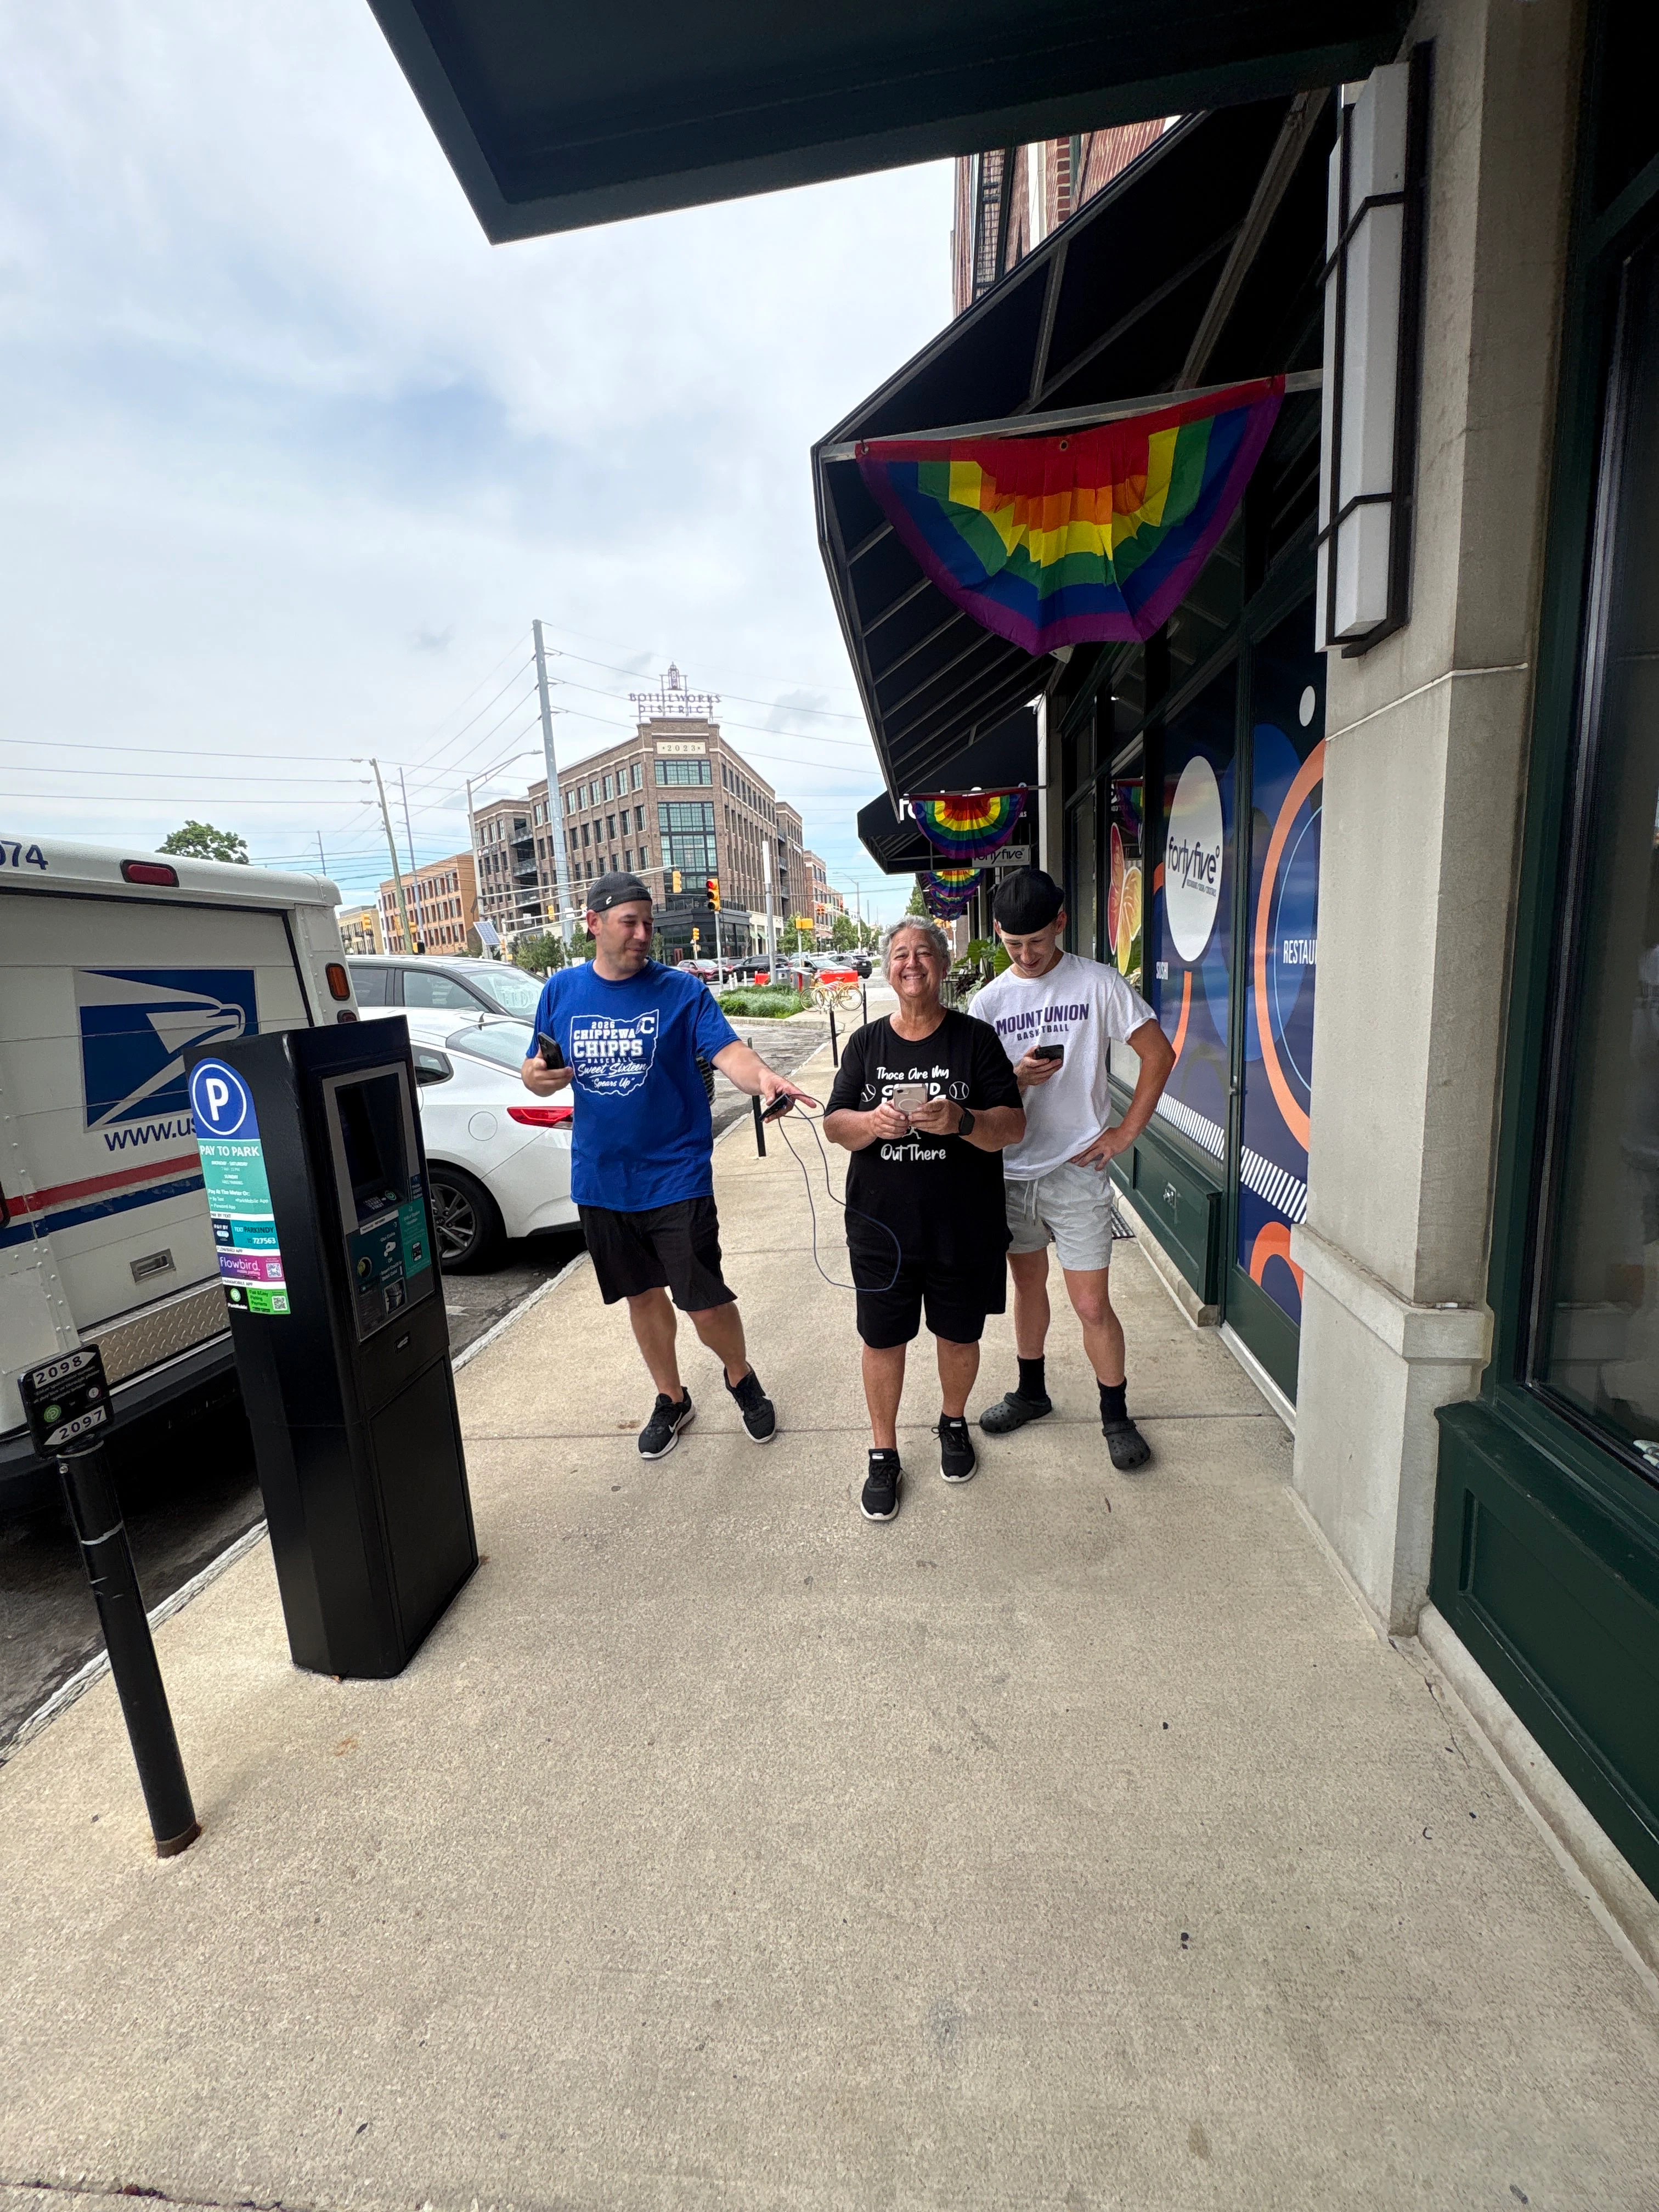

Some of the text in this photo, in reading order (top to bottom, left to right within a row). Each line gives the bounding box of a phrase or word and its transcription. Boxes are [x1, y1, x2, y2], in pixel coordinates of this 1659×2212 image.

[639, 705, 713, 713] DISTRICT
[0, 840, 49, 870] 74
[996, 1003, 1090, 1036] MOUNT UNION
[573, 1029, 636, 1040] CHIPPEWA
[1017, 1024, 1069, 1041] BASKTBALL
[573, 1039, 643, 1058] CHIPPS
[578, 1062, 647, 1076] Sweet Sixteen
[877, 1065, 949, 1080] Those Are My
[199, 1145, 260, 1157] PAY TO PARK
[881, 1144, 946, 1161] Out There
[36, 1356, 82, 1384] 2098
[59, 1409, 102, 1440] 2097
